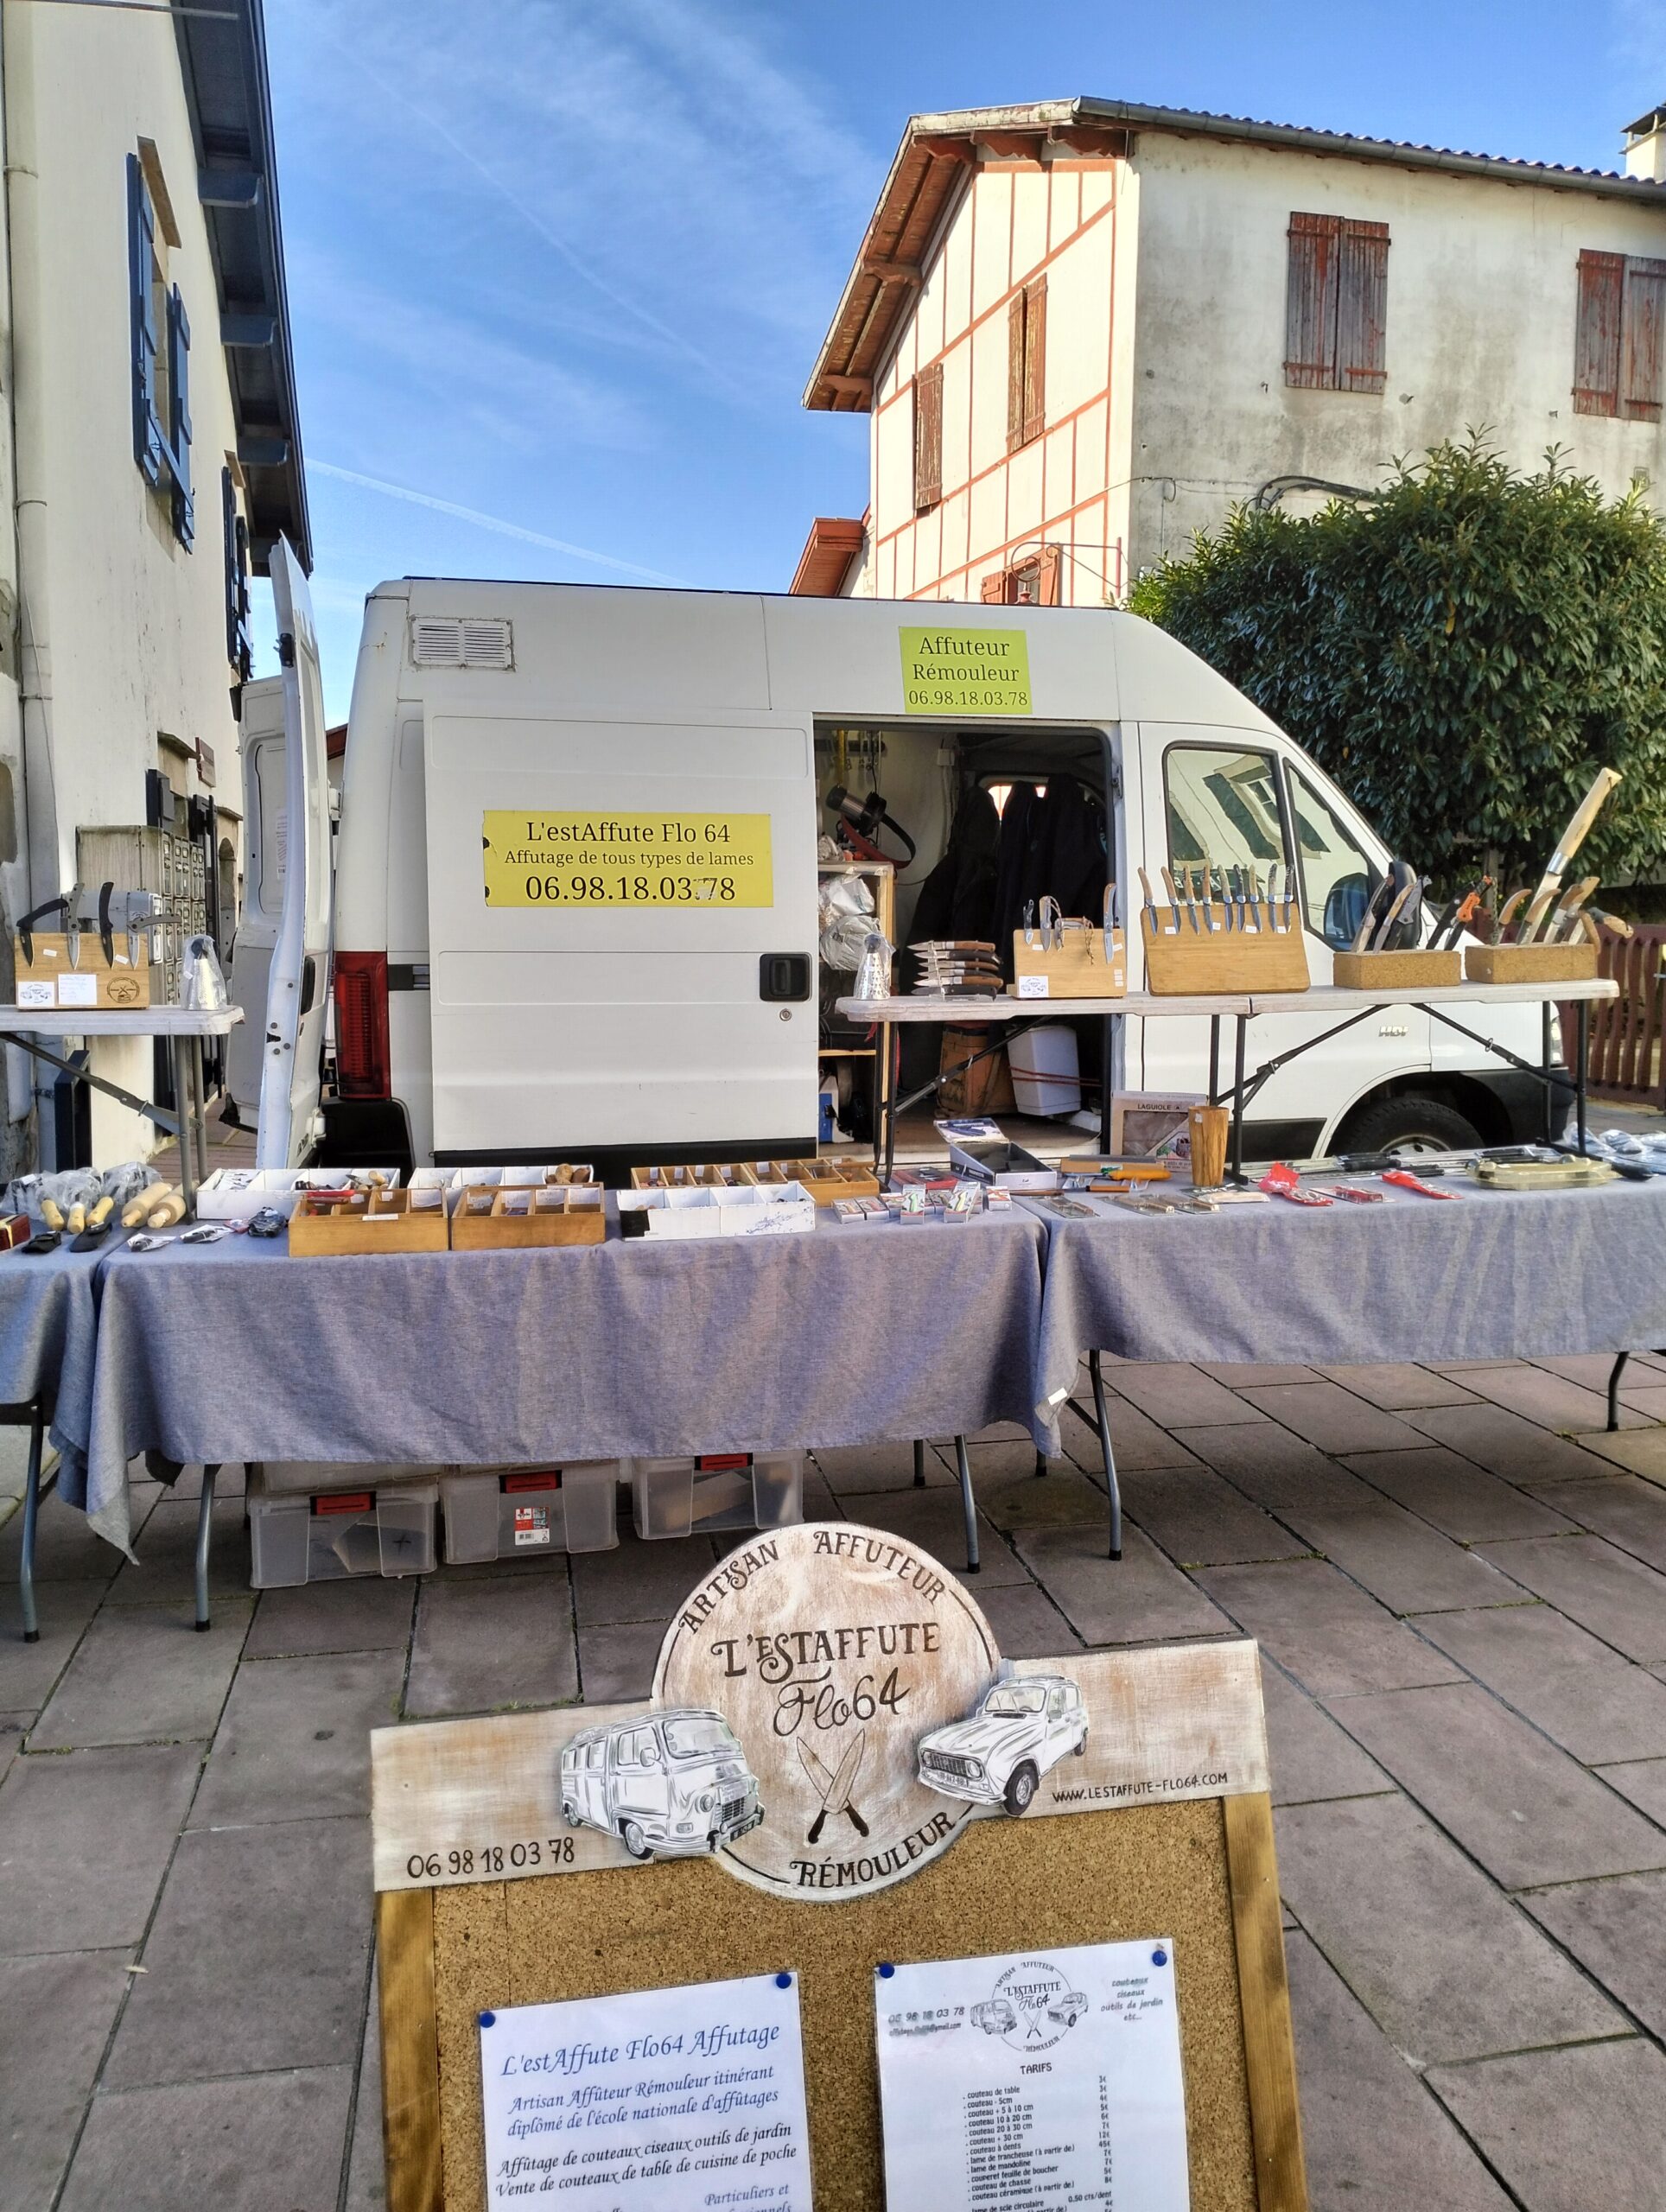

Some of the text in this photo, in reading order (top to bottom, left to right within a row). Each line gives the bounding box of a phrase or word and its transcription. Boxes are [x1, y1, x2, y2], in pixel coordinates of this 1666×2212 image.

[919, 636, 1010, 656] Affuteur
[912, 663, 1019, 682] Rémouleur
[908, 690, 1027, 706] 06.98.18.03.78
[526, 822, 730, 842] L'estAffute Flo 64
[505, 850, 754, 868] Affutage de tous types de lames
[678, 1530, 945, 1634] ARTISAN AFFUTEUR
[710, 1622, 940, 1684] L'ESTAFFUTE
[773, 1667, 911, 1737] Flo64
[1052, 1772, 1227, 1802] WWW.LESTAFFUTE-FLO64.COM
[790, 1811, 955, 1887] RÉMOULEUR
[407, 1836, 575, 1878] 06 98 18 03 78
[1112, 1977, 1148, 1986] couteaux
[1117, 1989, 1145, 1998] ciseaux
[954, 2006, 964, 2016] 78
[1101, 1998, 1163, 2012] outils de jardin
[499, 2024, 779, 2075] L'estAffute Flo64 Affutage
[1020, 2063, 1052, 2075] TARIFS
[507, 2065, 774, 2114] Artisan Affûteur Rémouleur itinérant
[968, 2090, 993, 2099] couteau
[1004, 2086, 1021, 2094] table
[968, 2100, 993, 2108] couteau
[507, 2090, 779, 2139] diplômé de l'école nationale d'affûtages
[968, 2109, 994, 2118] couteau
[969, 2119, 995, 2127] couteau
[969, 2127, 995, 2137] couteau
[970, 2137, 995, 2146] couteau
[1003, 2133, 1012, 2142] 30
[1003, 2142, 1021, 2151] dents
[496, 2122, 792, 2178] Affûtage de couteaux ciseaux outils de jardin
[998, 2151, 1033, 2160] trancheuse
[496, 2144, 797, 2197] Vente de couteaux de table de cuisine de poche
[998, 2160, 1031, 2171] mandoline
[1033, 2165, 1059, 2175] boucher
[704, 2184, 789, 2205] Particuliers et
[972, 2183, 997, 2192] couteau
[972, 2192, 998, 2202] couteau
[1014, 2200, 1044, 2209] circulaire
